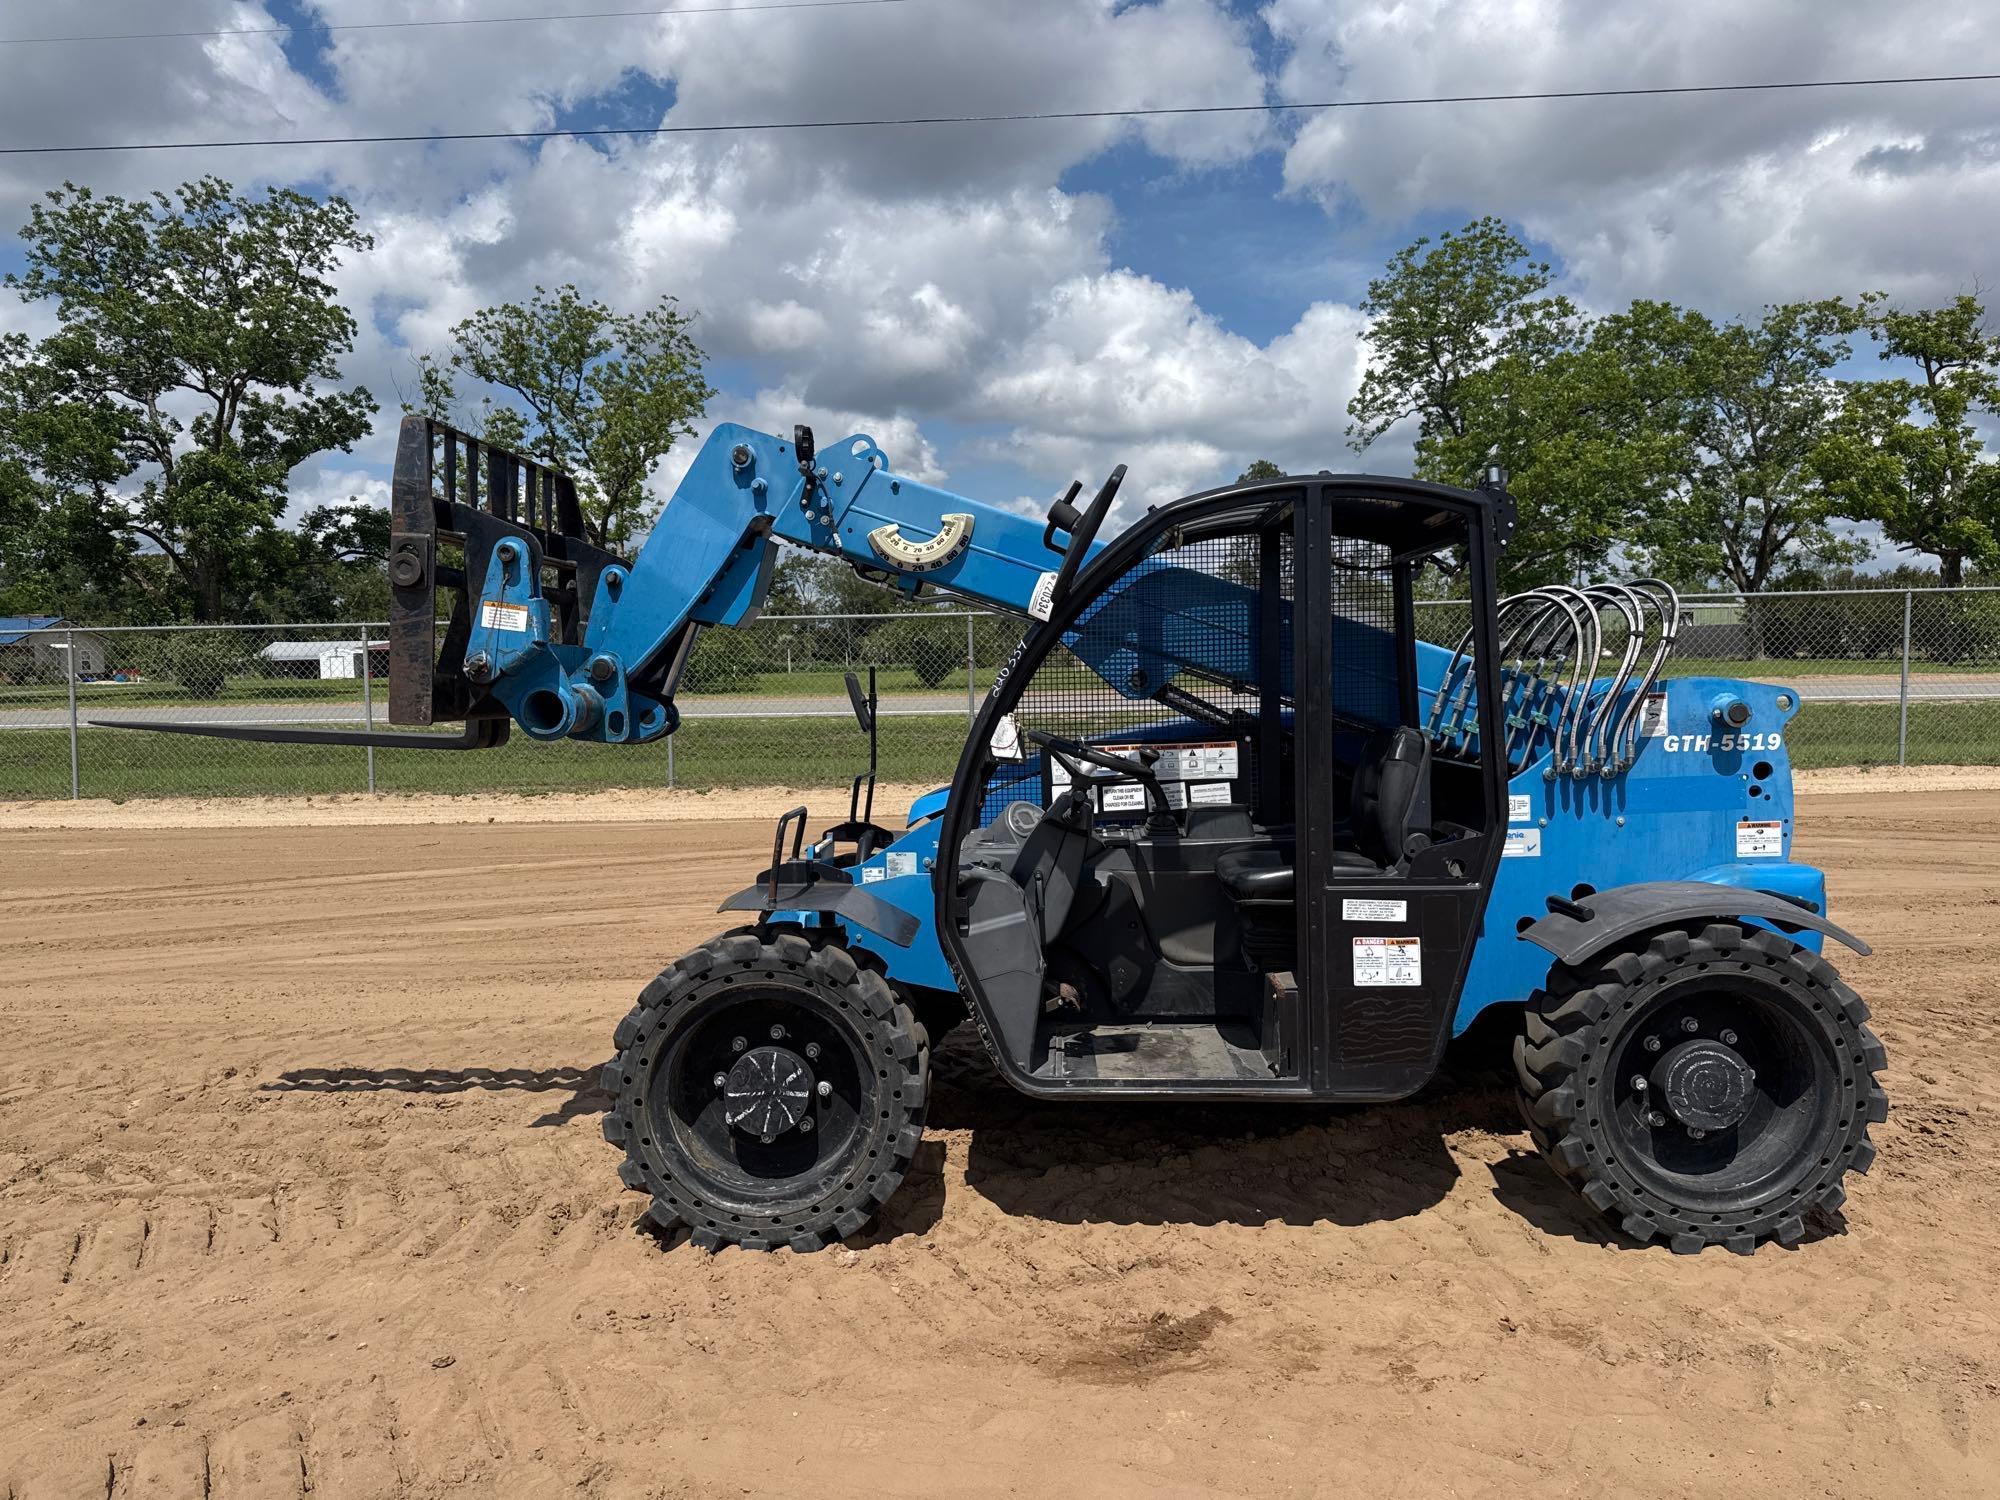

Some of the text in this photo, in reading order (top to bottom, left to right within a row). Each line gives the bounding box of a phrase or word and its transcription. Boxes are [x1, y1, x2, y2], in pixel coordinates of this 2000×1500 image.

[936, 538, 945, 546] 60
[944, 528, 952, 536] 80
[912, 564, 925, 572] 20
[930, 560, 943, 570] 40
[946, 549, 958, 562] 60
[958, 534, 969, 548] 80
[1663, 733, 1781, 752] GTH-5519
